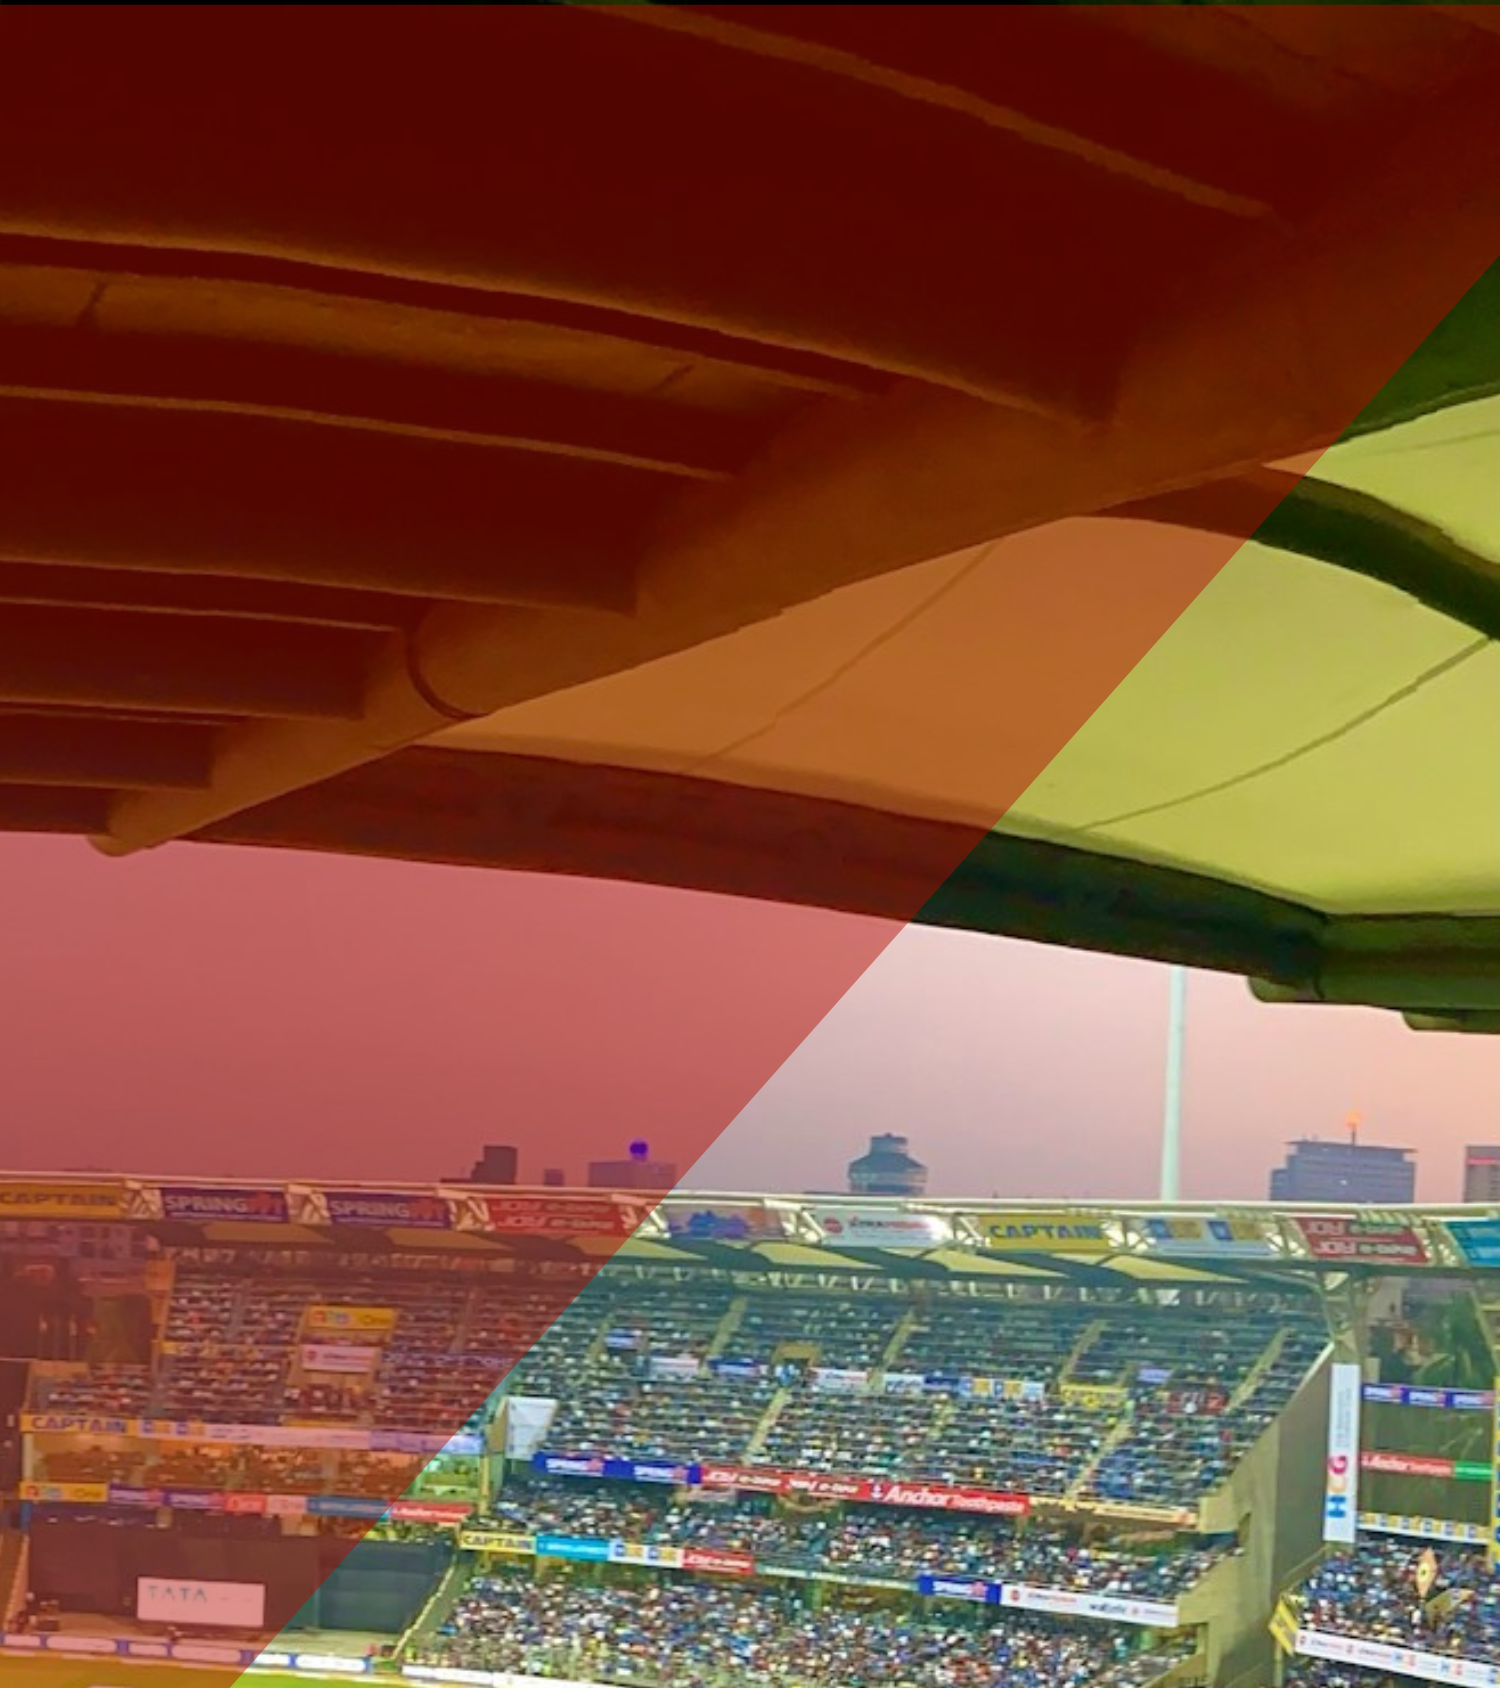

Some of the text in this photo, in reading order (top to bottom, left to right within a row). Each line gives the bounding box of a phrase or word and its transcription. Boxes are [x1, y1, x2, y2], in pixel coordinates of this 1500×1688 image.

[987, 1224, 1099, 1241] CAPTAIN
[32, 1416, 126, 1434] CAPTAIN
[885, 1484, 948, 1507] Anchor
[462, 1535, 534, 1549] CAPTAIN
[147, 1586, 207, 1602] TATA
